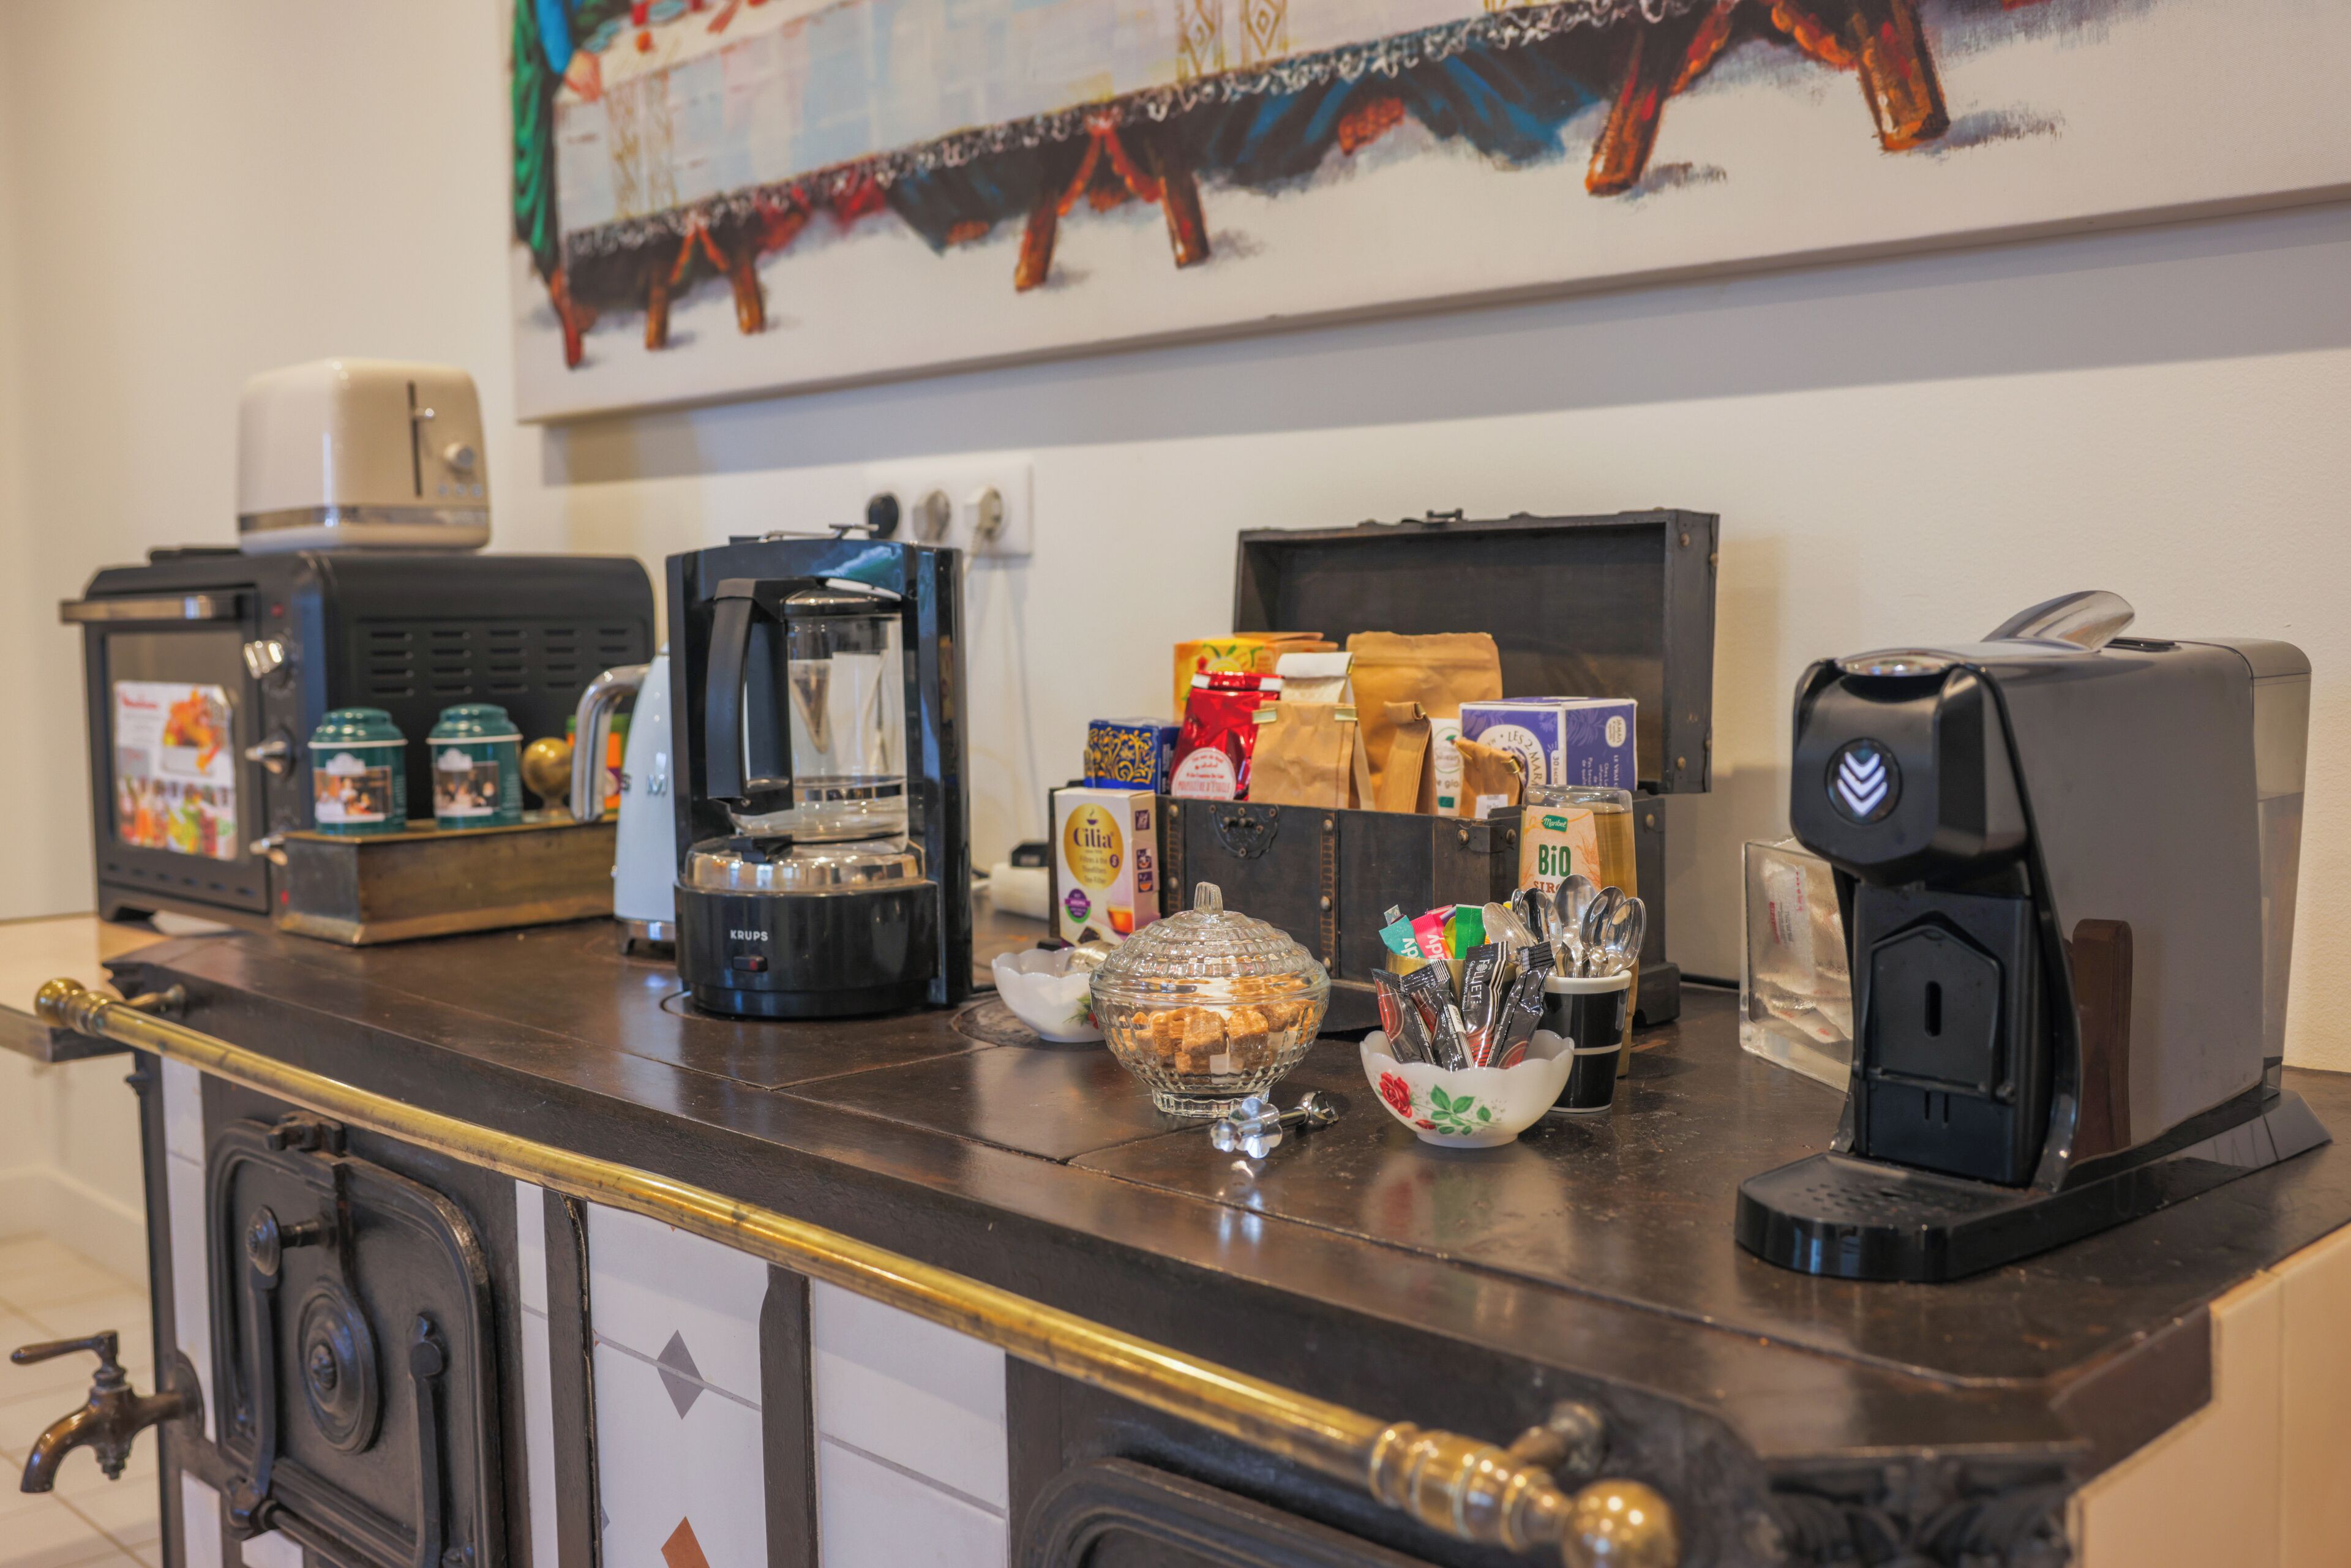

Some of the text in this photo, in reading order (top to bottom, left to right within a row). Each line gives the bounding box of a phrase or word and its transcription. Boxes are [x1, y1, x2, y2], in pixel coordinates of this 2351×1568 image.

[1508, 730, 1524, 745] LES
[1524, 739, 1533, 750] 2
[1553, 756, 1559, 765] 30
[1543, 817, 1567, 828] Maribel
[1073, 827, 1112, 849] Cilia
[730, 929, 768, 941] KRUPS
